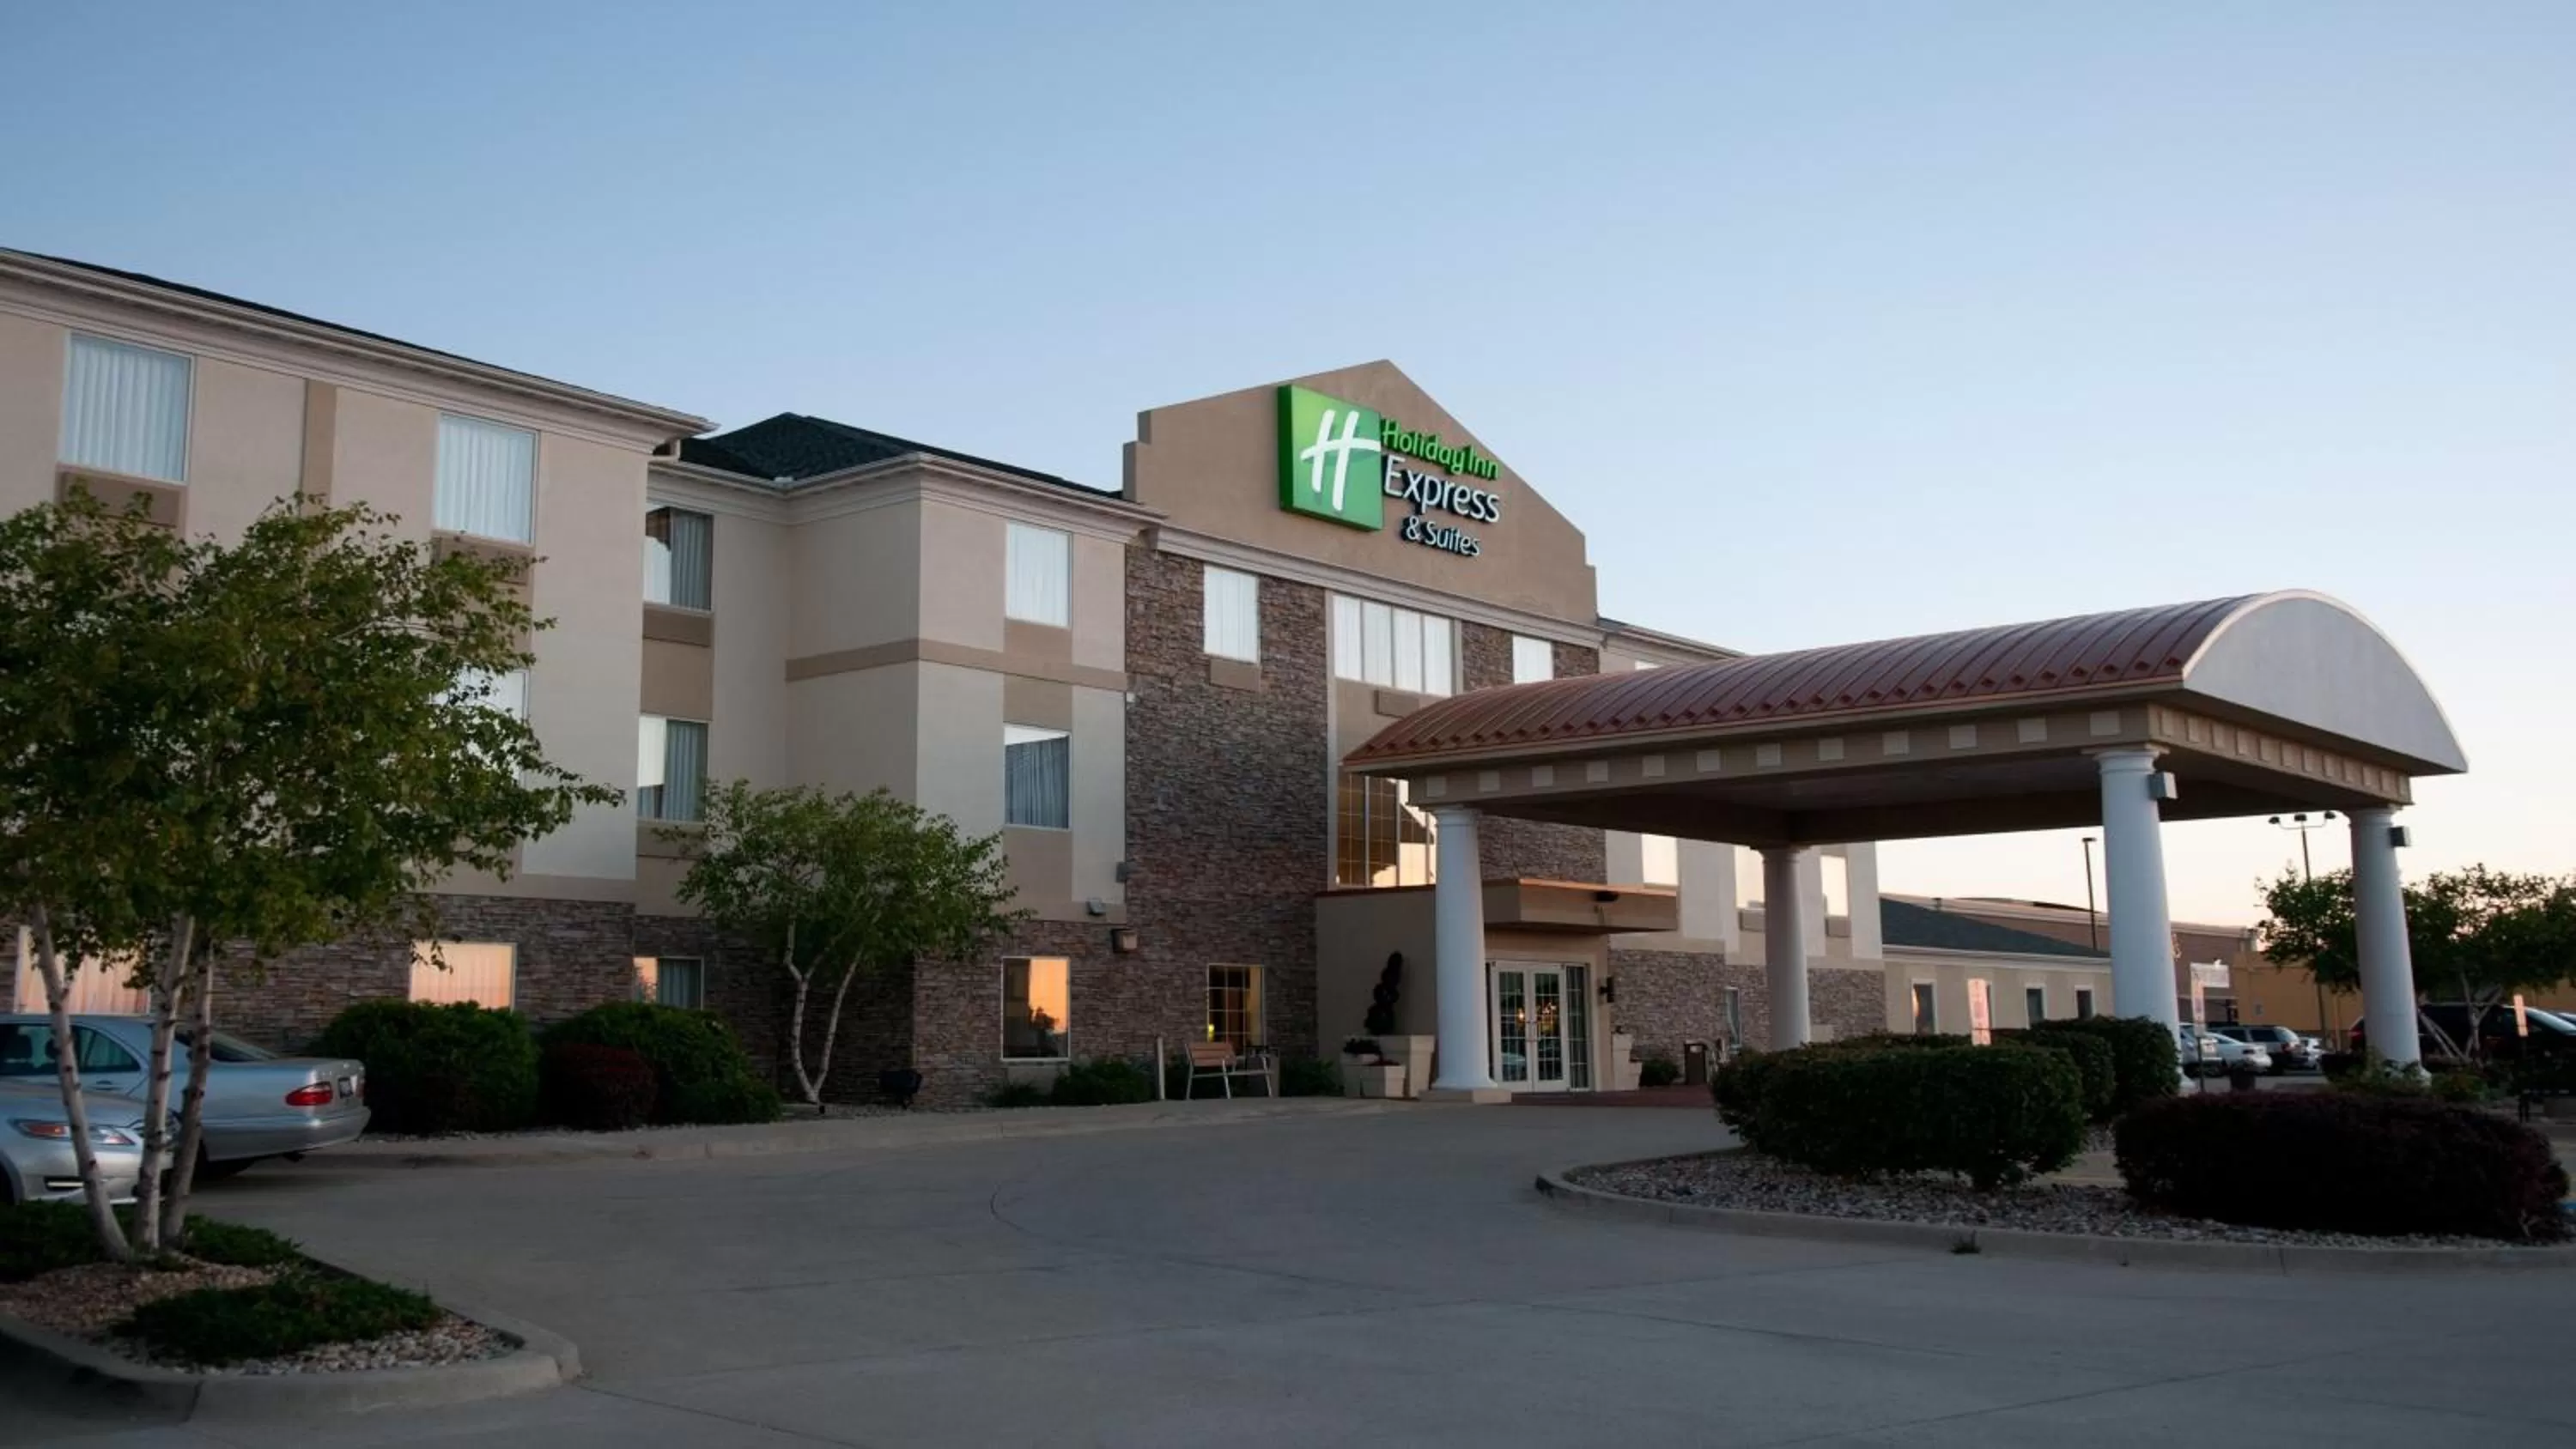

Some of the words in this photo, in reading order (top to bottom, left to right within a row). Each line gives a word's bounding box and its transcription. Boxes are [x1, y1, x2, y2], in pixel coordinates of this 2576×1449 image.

[1382, 419, 1463, 474] Holiday
[1467, 446, 1499, 481] Inn
[1384, 454, 1501, 524] Express
[1405, 517, 1420, 541] &
[1424, 520, 1481, 558] Suites
